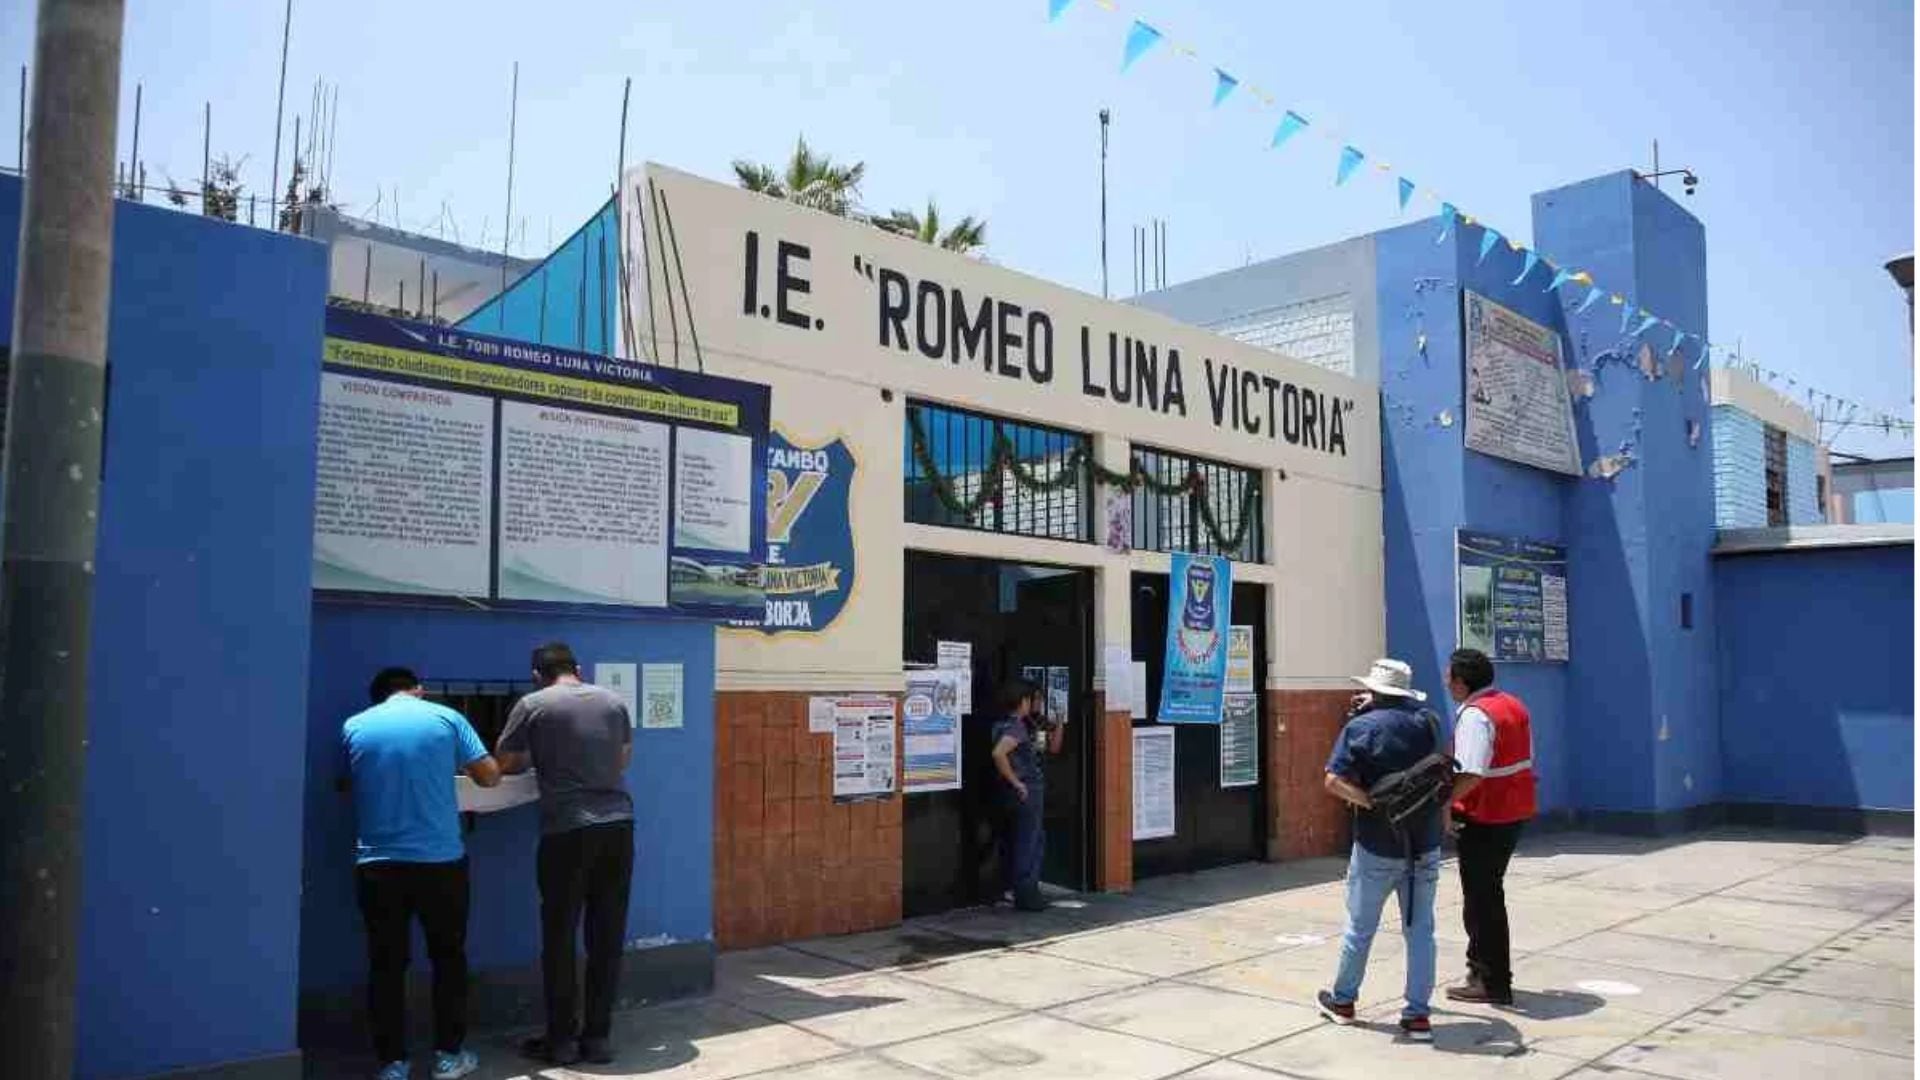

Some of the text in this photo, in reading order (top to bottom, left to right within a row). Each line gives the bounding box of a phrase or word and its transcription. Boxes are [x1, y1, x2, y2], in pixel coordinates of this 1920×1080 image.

[743, 230, 825, 331] I.E.
[853, 253, 1054, 385] "ROMEO
[1080, 325, 1187, 418] LUNA
[1204, 357, 1354, 457] VICTORIA"
[504, 344, 552, 363] ROMEO
[555, 355, 591, 371] LUNA
[594, 359, 653, 381] VICTORIA
[764, 599, 813, 627] BORJA
